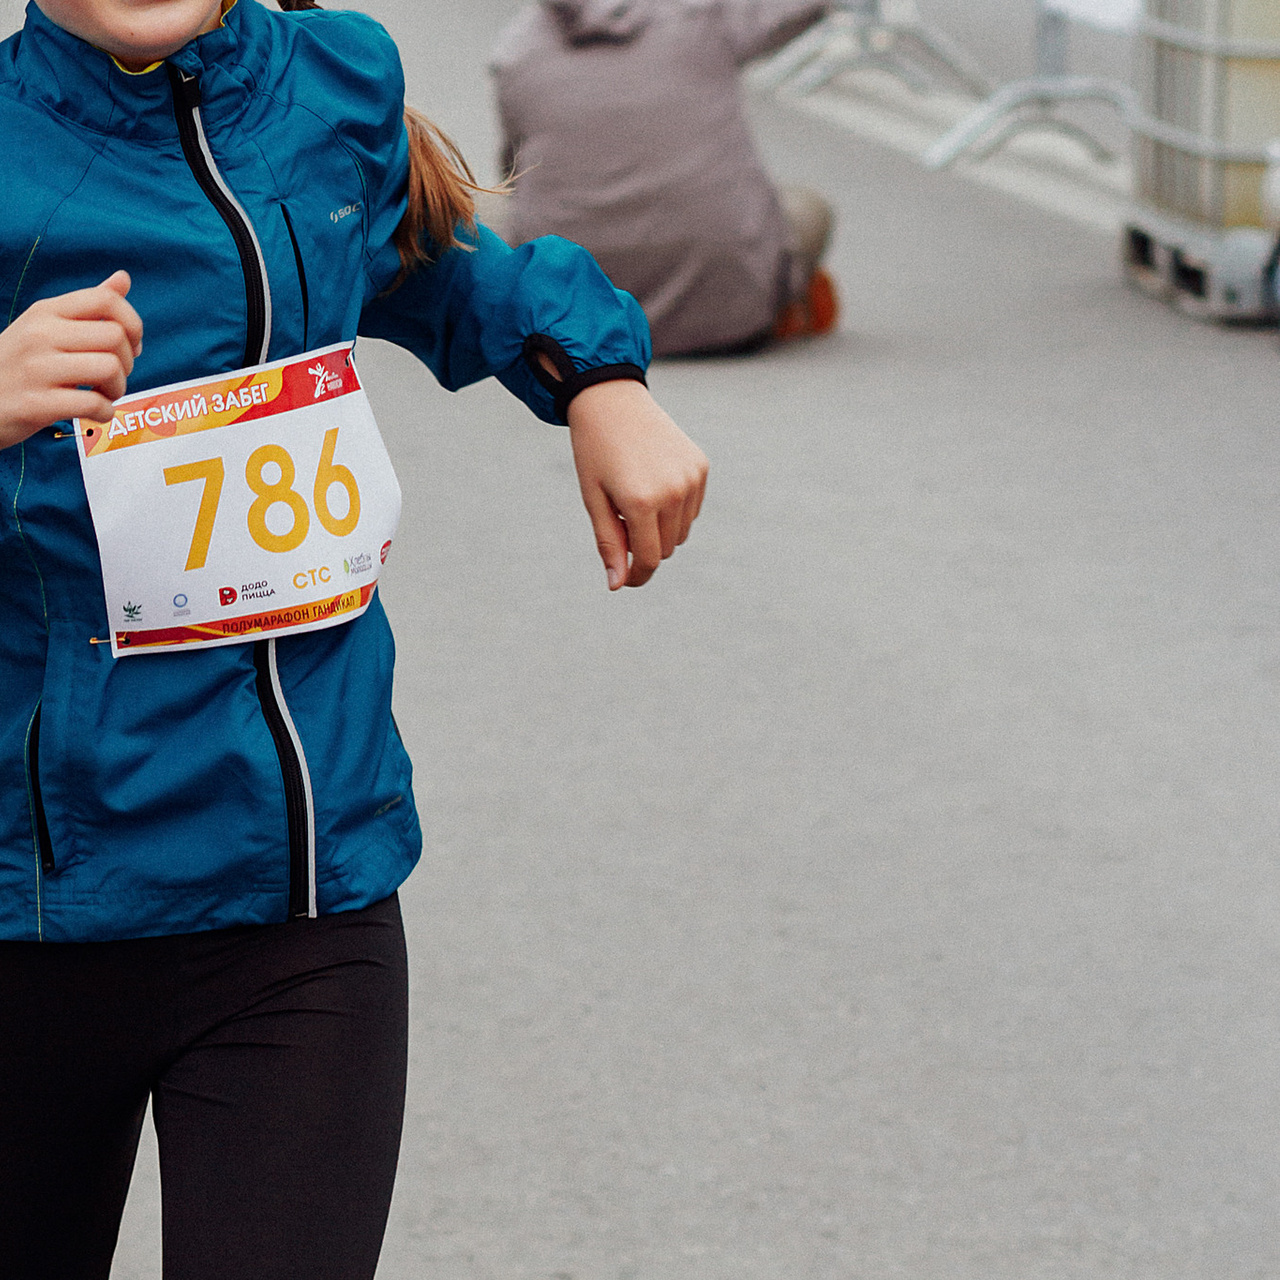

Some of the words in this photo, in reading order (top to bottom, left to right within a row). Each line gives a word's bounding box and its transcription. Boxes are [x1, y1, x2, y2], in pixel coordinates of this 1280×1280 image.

[108, 393, 207, 439] ДЕТСКИЙ
[211, 383, 268, 413] ЗАБЕГ
[163, 427, 361, 571] 786
[241, 580, 268, 593] ДОДО
[293, 566, 331, 589] СТС
[242, 588, 275, 601] ПИЦЦА
[223, 608, 309, 634] ПОЛУМАРАФОН
[313, 595, 355, 617] ГАНДИКАП
